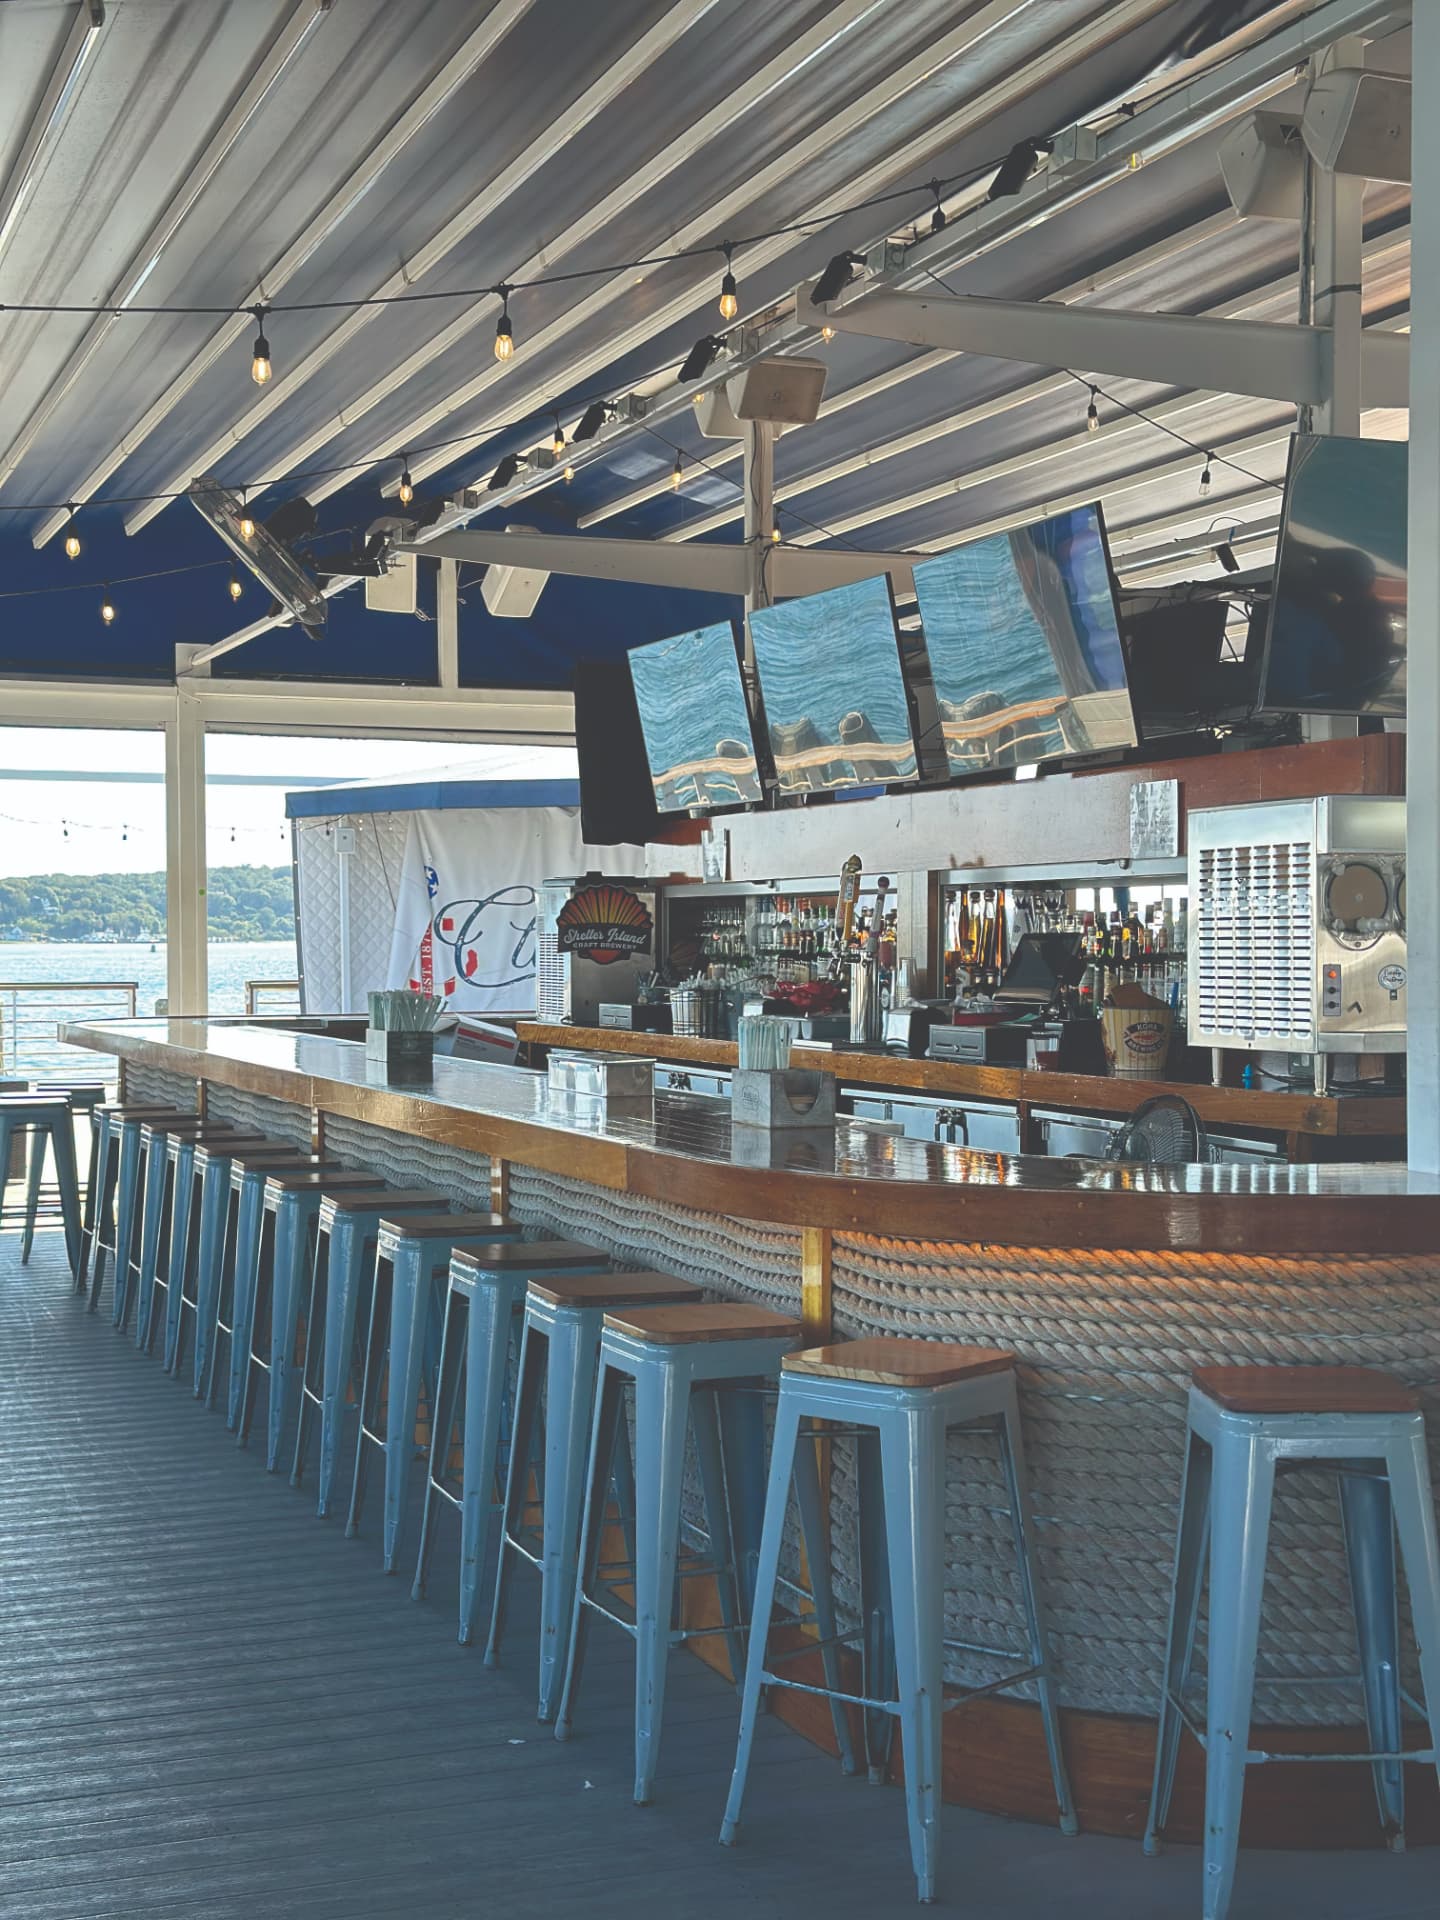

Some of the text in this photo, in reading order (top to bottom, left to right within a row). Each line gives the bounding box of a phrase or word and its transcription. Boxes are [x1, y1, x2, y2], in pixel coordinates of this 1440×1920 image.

[607, 928, 647, 944] Island
[600, 942, 637, 950] BREWERY
[421, 964, 432, 994] EST.
